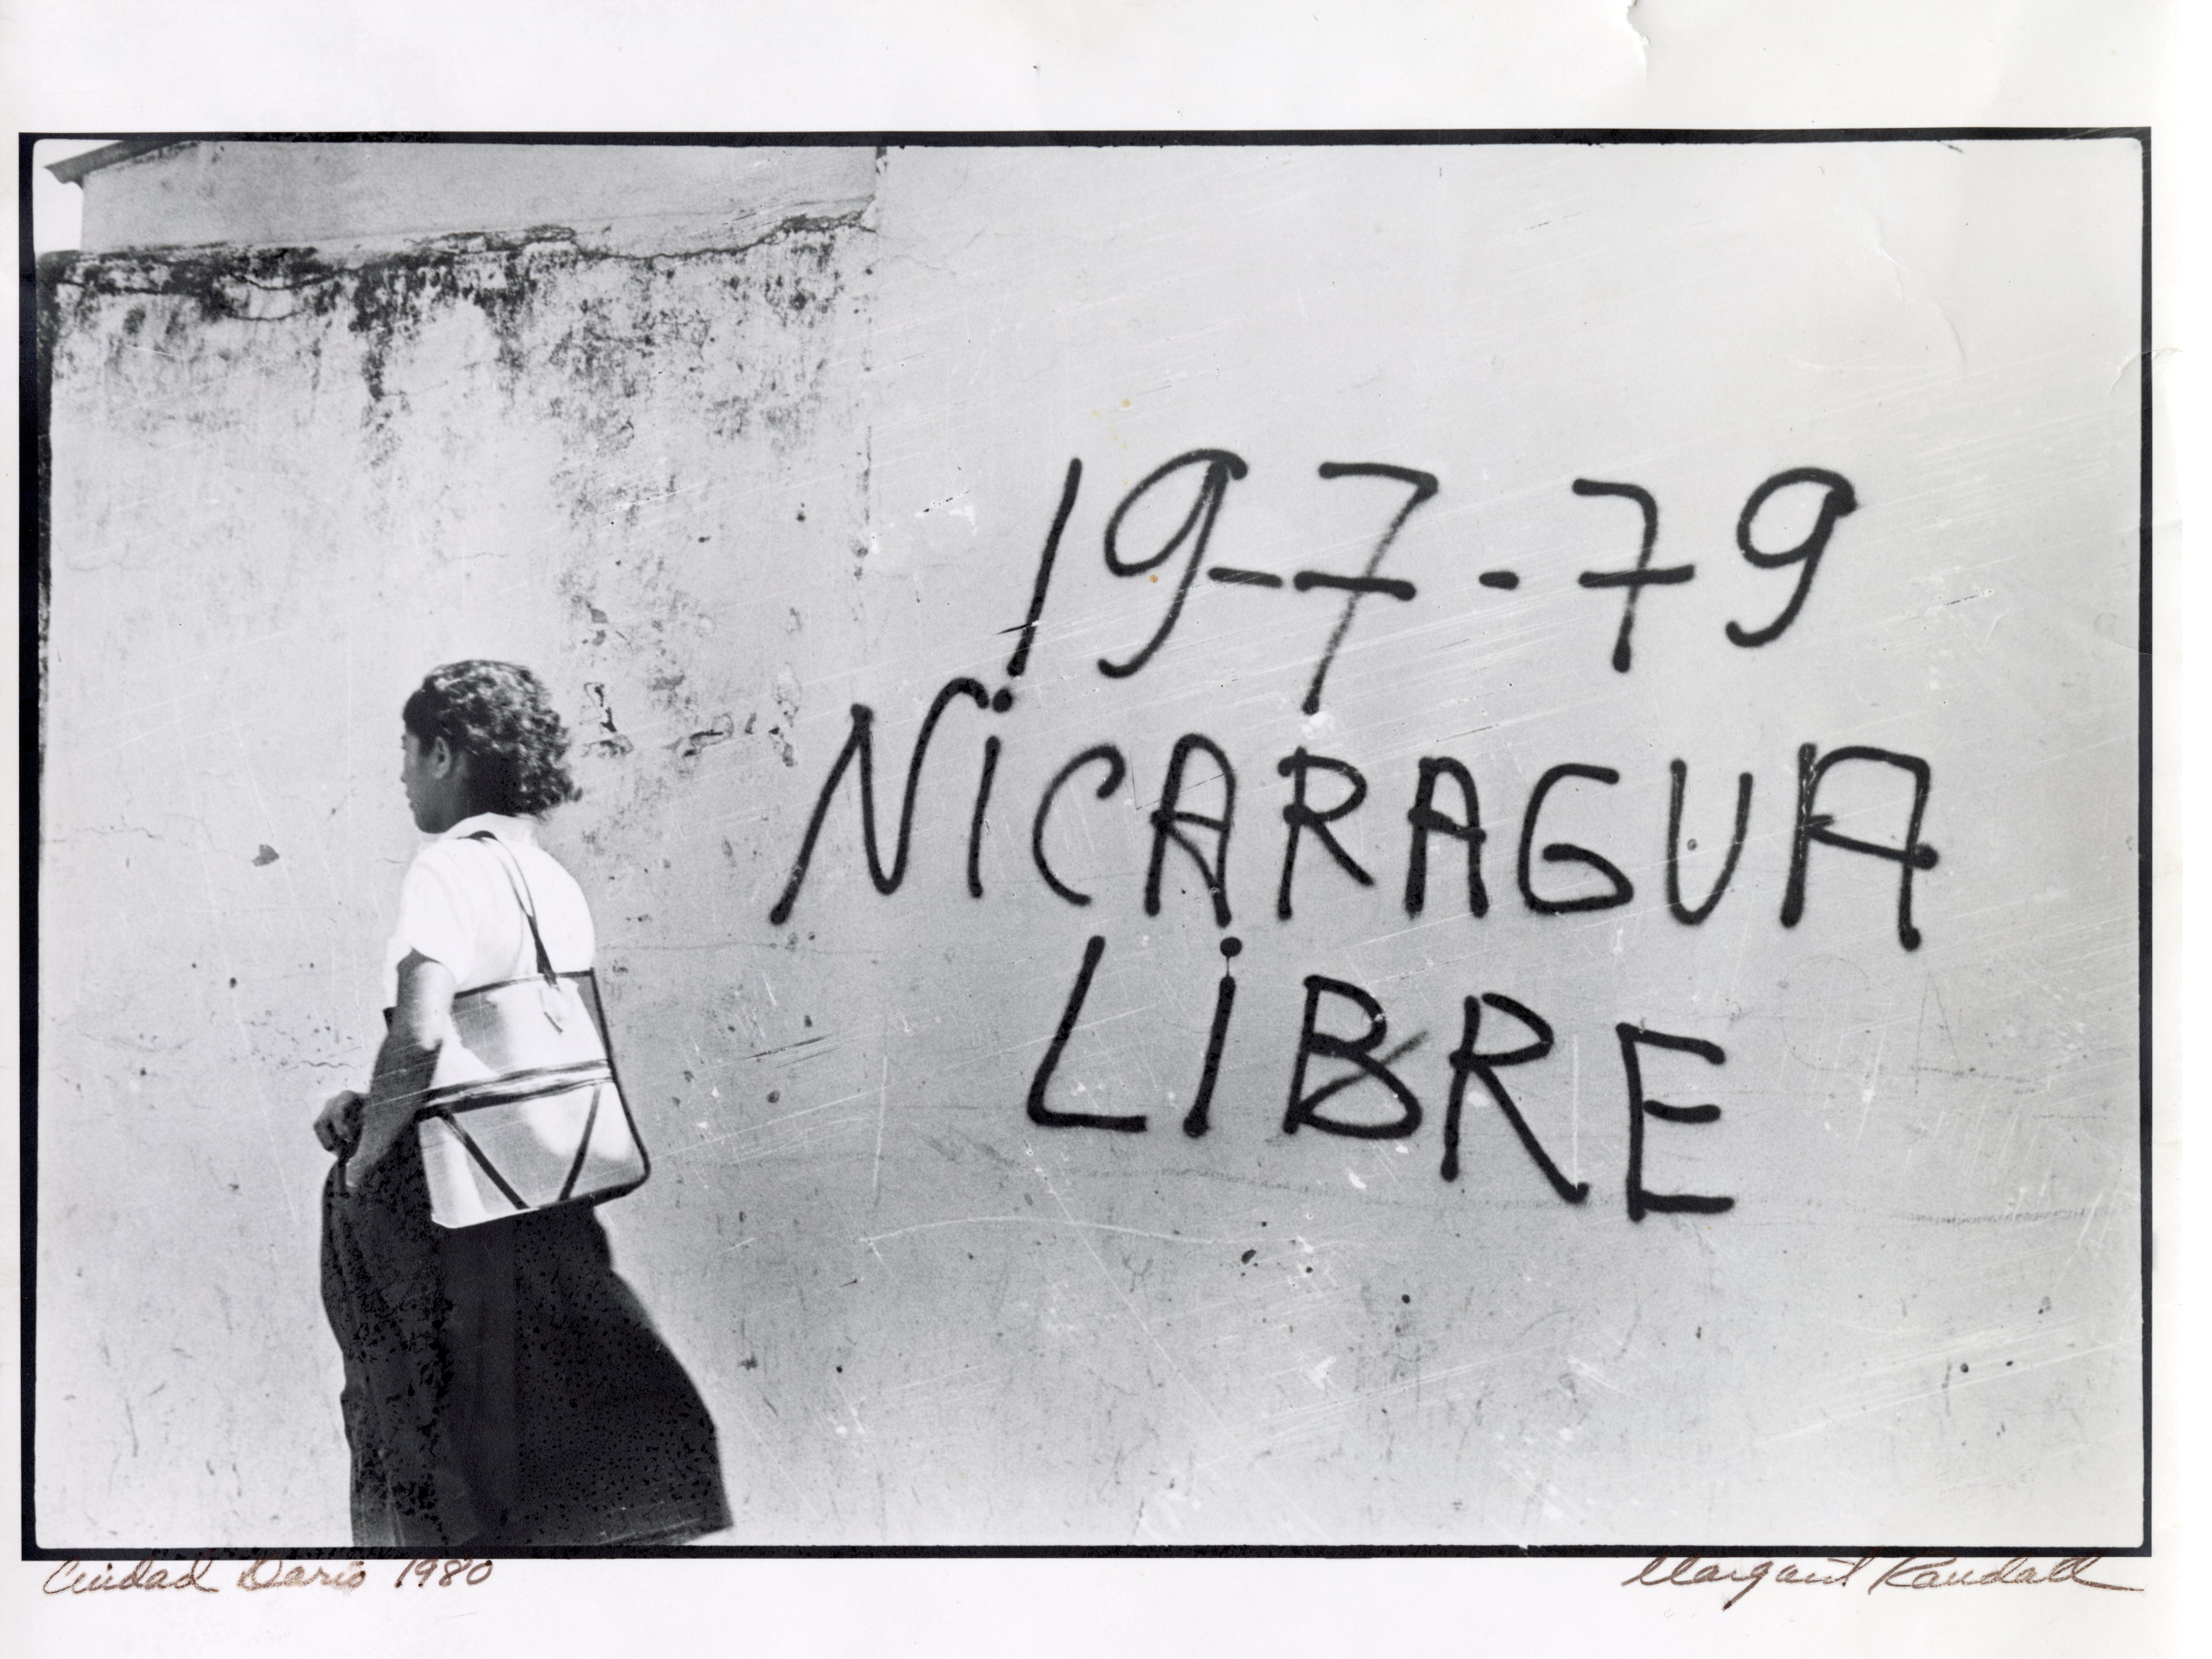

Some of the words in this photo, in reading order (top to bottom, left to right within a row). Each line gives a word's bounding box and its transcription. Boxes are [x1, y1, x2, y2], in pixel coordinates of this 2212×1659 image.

[1006, 448, 1859, 715] 19-7-79
[41, 1553, 219, 1595] Ciudad
[395, 1554, 494, 1590] 1980
[1866, 1551, 2145, 1595] Randall
